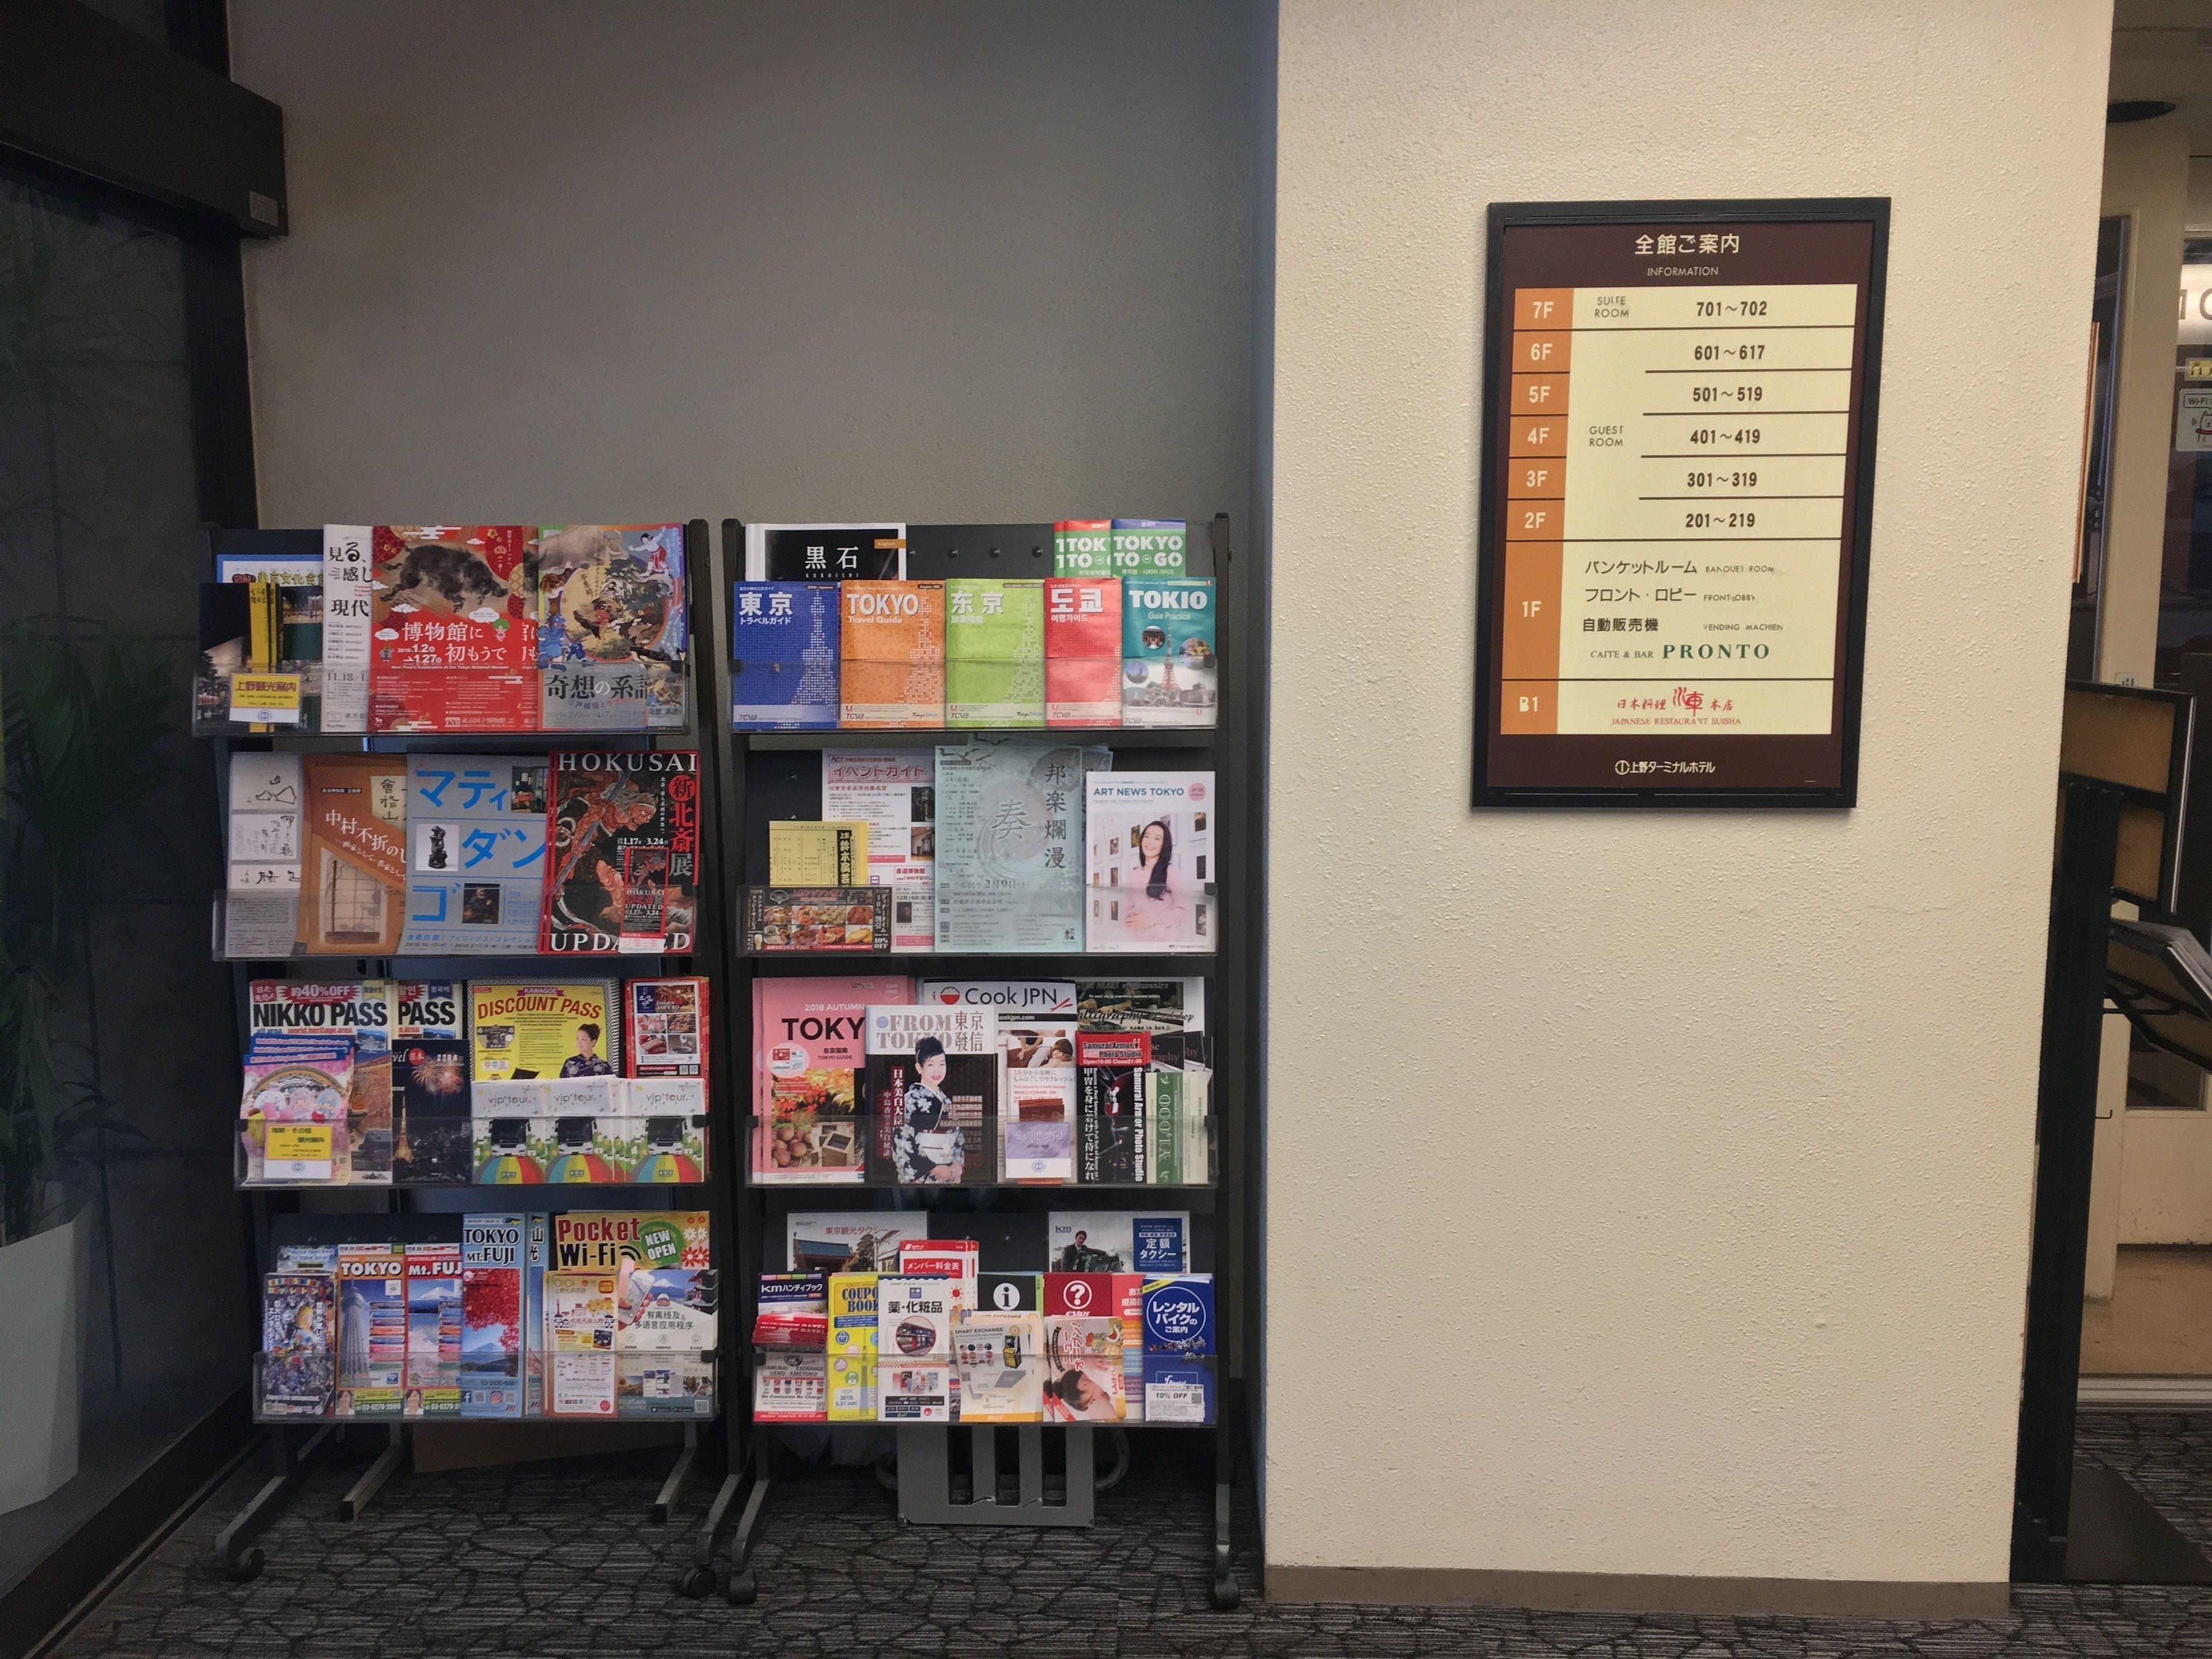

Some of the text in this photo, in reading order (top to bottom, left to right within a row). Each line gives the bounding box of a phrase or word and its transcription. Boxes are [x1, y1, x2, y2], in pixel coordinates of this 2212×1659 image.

[1635, 233, 1740, 255] 全館ご案内
[1647, 266, 1719, 277] INFORMATION
[1532, 301, 1555, 319] 7F
[1594, 308, 1630, 319] ROOM
[1530, 344, 1553, 361] 6F
[1528, 385, 1551, 403] 5F
[1527, 427, 1550, 445] 4F
[1589, 425, 1623, 436] GUEST
[1589, 437, 1624, 448] ROOM
[1525, 470, 1548, 487] 3F
[1524, 511, 1546, 529] 2F
[1113, 536, 1183, 551] TOKYO
[805, 546, 859, 570] 黒石
[1113, 552, 1183, 567] TO GO
[1585, 560, 1698, 574] バンケットルーム
[331, 599, 370, 617] 現代
[738, 591, 793, 616] 東京
[846, 593, 919, 616] TOKYO
[950, 589, 1005, 615] 东京
[1050, 588, 1104, 613] 도쿄
[1128, 590, 1207, 609] TOKIO
[1521, 600, 1541, 618] 1F
[740, 617, 791, 625] トラベルガイド
[848, 616, 903, 624] Travel Guide
[1582, 618, 1659, 632] 自動販売機
[402, 622, 484, 642] 博物館に
[444, 643, 507, 663] 初もうで
[1634, 651, 1654, 659] BAR
[1662, 643, 1770, 660] PRONTO
[234, 680, 297, 692] 上野観光案内
[1519, 697, 1539, 713] B1
[1617, 698, 1666, 711] 日本料理
[1710, 699, 1733, 711] 本店
[1612, 718, 1650, 726] JAPANESE
[557, 753, 698, 772] HOKUSAI
[1630, 760, 1716, 774] 上野ターミナルホテル
[1093, 787, 1184, 796] ART NEWS TOKYO
[991, 798, 1033, 840] 奏
[1044, 762, 1067, 870] 邦楽爛漫
[461, 827, 547, 870] ダン
[412, 882, 461, 922] ゴ
[965, 986, 1058, 1007] Cook JPN
[253, 1002, 388, 1028] NIKKO PASS
[397, 1001, 457, 1026] PASS
[478, 996, 559, 1020] DISCOUNT
[560, 998, 602, 1019] PASS
[826, 1003, 865, 1011] AUTUMN
[889, 1014, 952, 1032] FROM
[955, 1010, 984, 1031] 東京
[1077, 1008, 1144, 1024] alligraphy
[781, 1017, 866, 1040] TOKY
[1083, 1041, 1133, 1050] Samurai Armor
[410, 1052, 425, 1061] 日本
[1133, 1067, 1143, 1101] Samurai
[1133, 1129, 1143, 1152] Photo
[1133, 1154, 1143, 1181] Studio
[464, 1228, 520, 1244] TOKYO
[558, 1217, 641, 1243] Pocket
[825, 1226, 888, 1235] 東京観光タクシー
[1055, 1225, 1071, 1233] km
[645, 1229, 671, 1247] NEW
[1146, 1238, 1171, 1249] 定額
[483, 1247, 515, 1265] FUJI
[559, 1243, 616, 1266] Wi-Fi
[647, 1243, 677, 1260] OPEN
[1139, 1249, 1177, 1259] タクシー
[340, 1261, 402, 1277] TOKYO
[408, 1261, 463, 1276] Mt. FUJ
[907, 1262, 960, 1270] メンバー料金表
[842, 1287, 878, 1301] COUPO
[888, 1301, 943, 1313] 薬・化粧品
[1153, 1301, 1200, 1314] レンタル
[1156, 1313, 1198, 1325] バイクの
